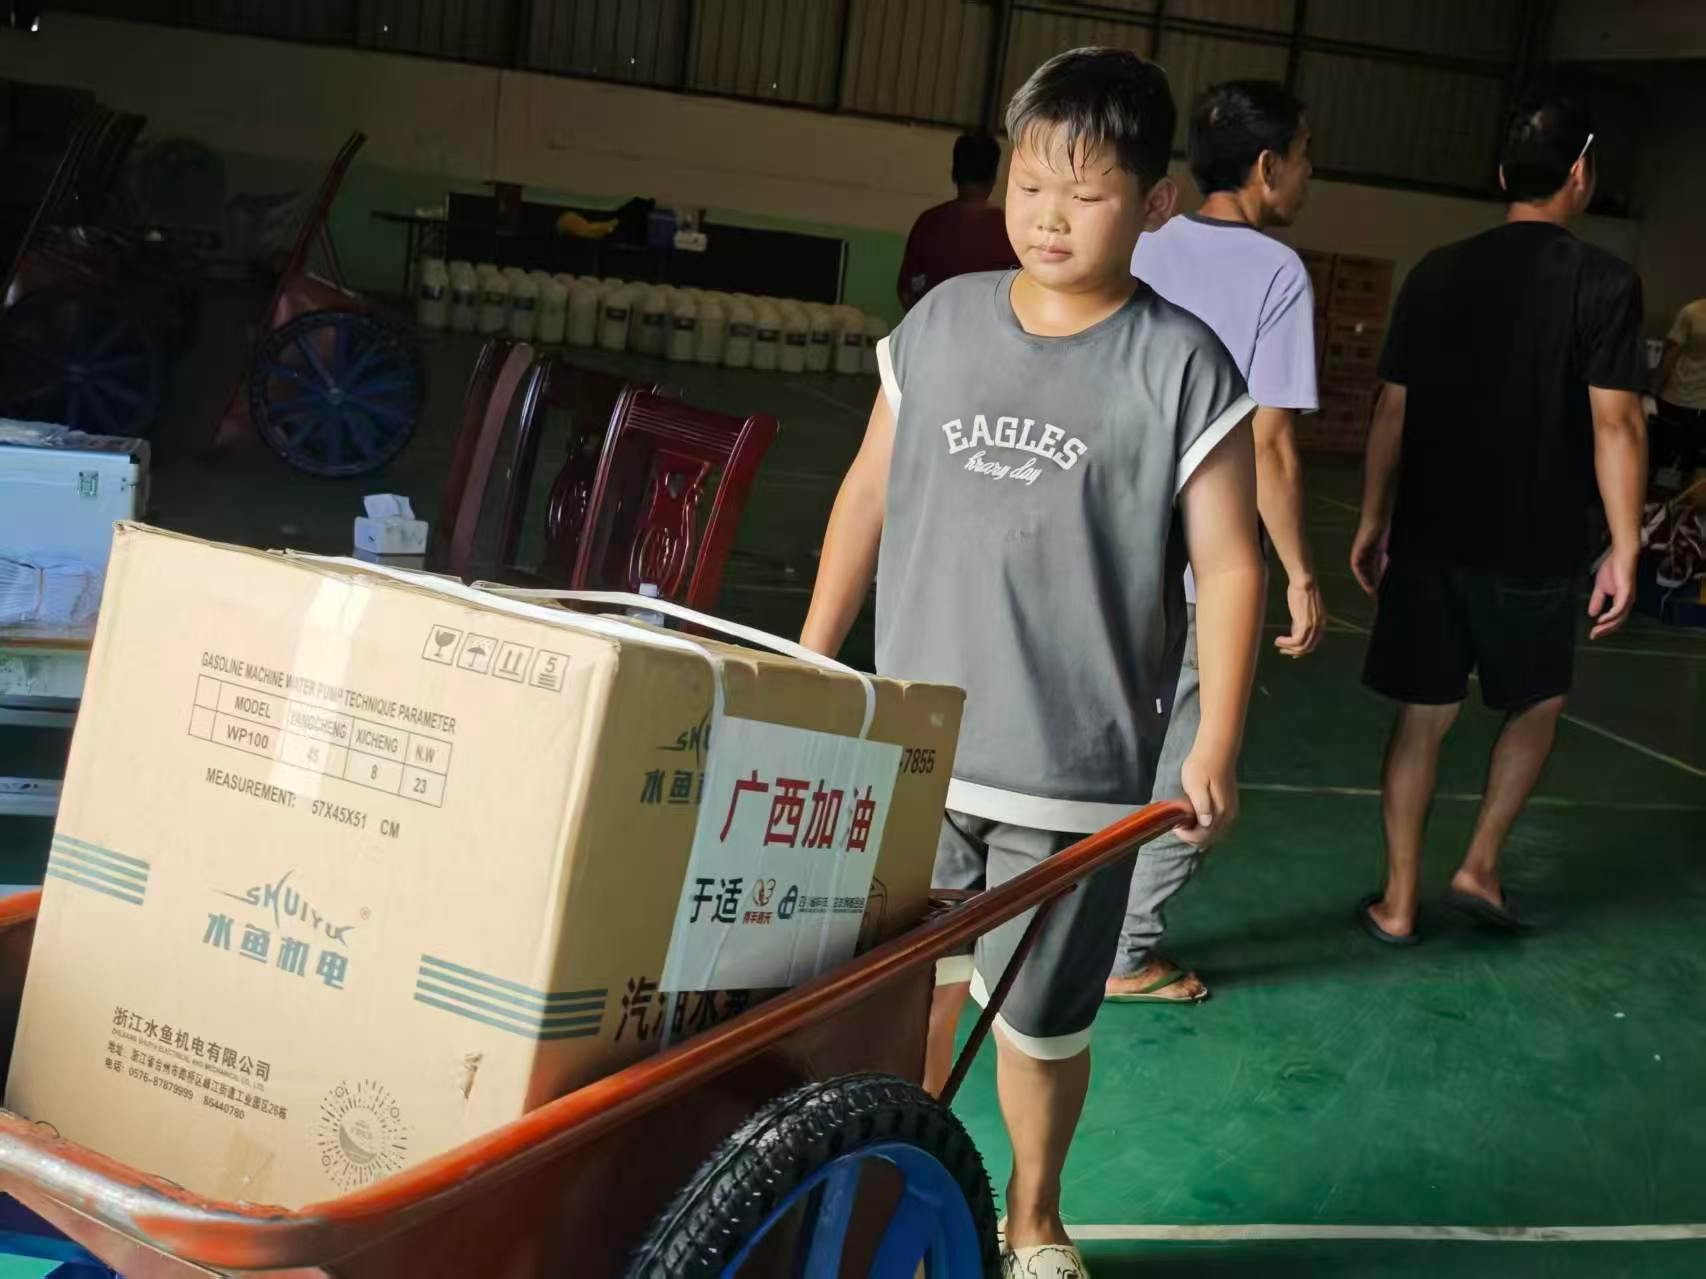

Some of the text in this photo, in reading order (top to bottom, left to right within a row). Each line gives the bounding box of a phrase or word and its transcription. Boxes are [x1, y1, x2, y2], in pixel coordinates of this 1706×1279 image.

[942, 414, 1088, 470] EAGLES
[201, 651, 243, 678] GASOLINE
[244, 663, 284, 688] MACHINE
[344, 689, 397, 719] TECHNIQUE
[398, 704, 457, 734] PARAMETER
[234, 695, 272, 719] MODEL
[355, 728, 399, 753] XICHENG
[226, 723, 270, 749] WP100
[413, 776, 427, 794] 23
[640, 768, 706, 805] 水鱼
[205, 767, 401, 840] MEASUREMENT: 57X45X51 CM
[719, 769, 877, 853] 广西加油
[690, 877, 744, 924] 于适
[203, 912, 349, 991] 水鱼机电
[112, 1006, 270, 1082] 浙江水鱼机电有限公司
